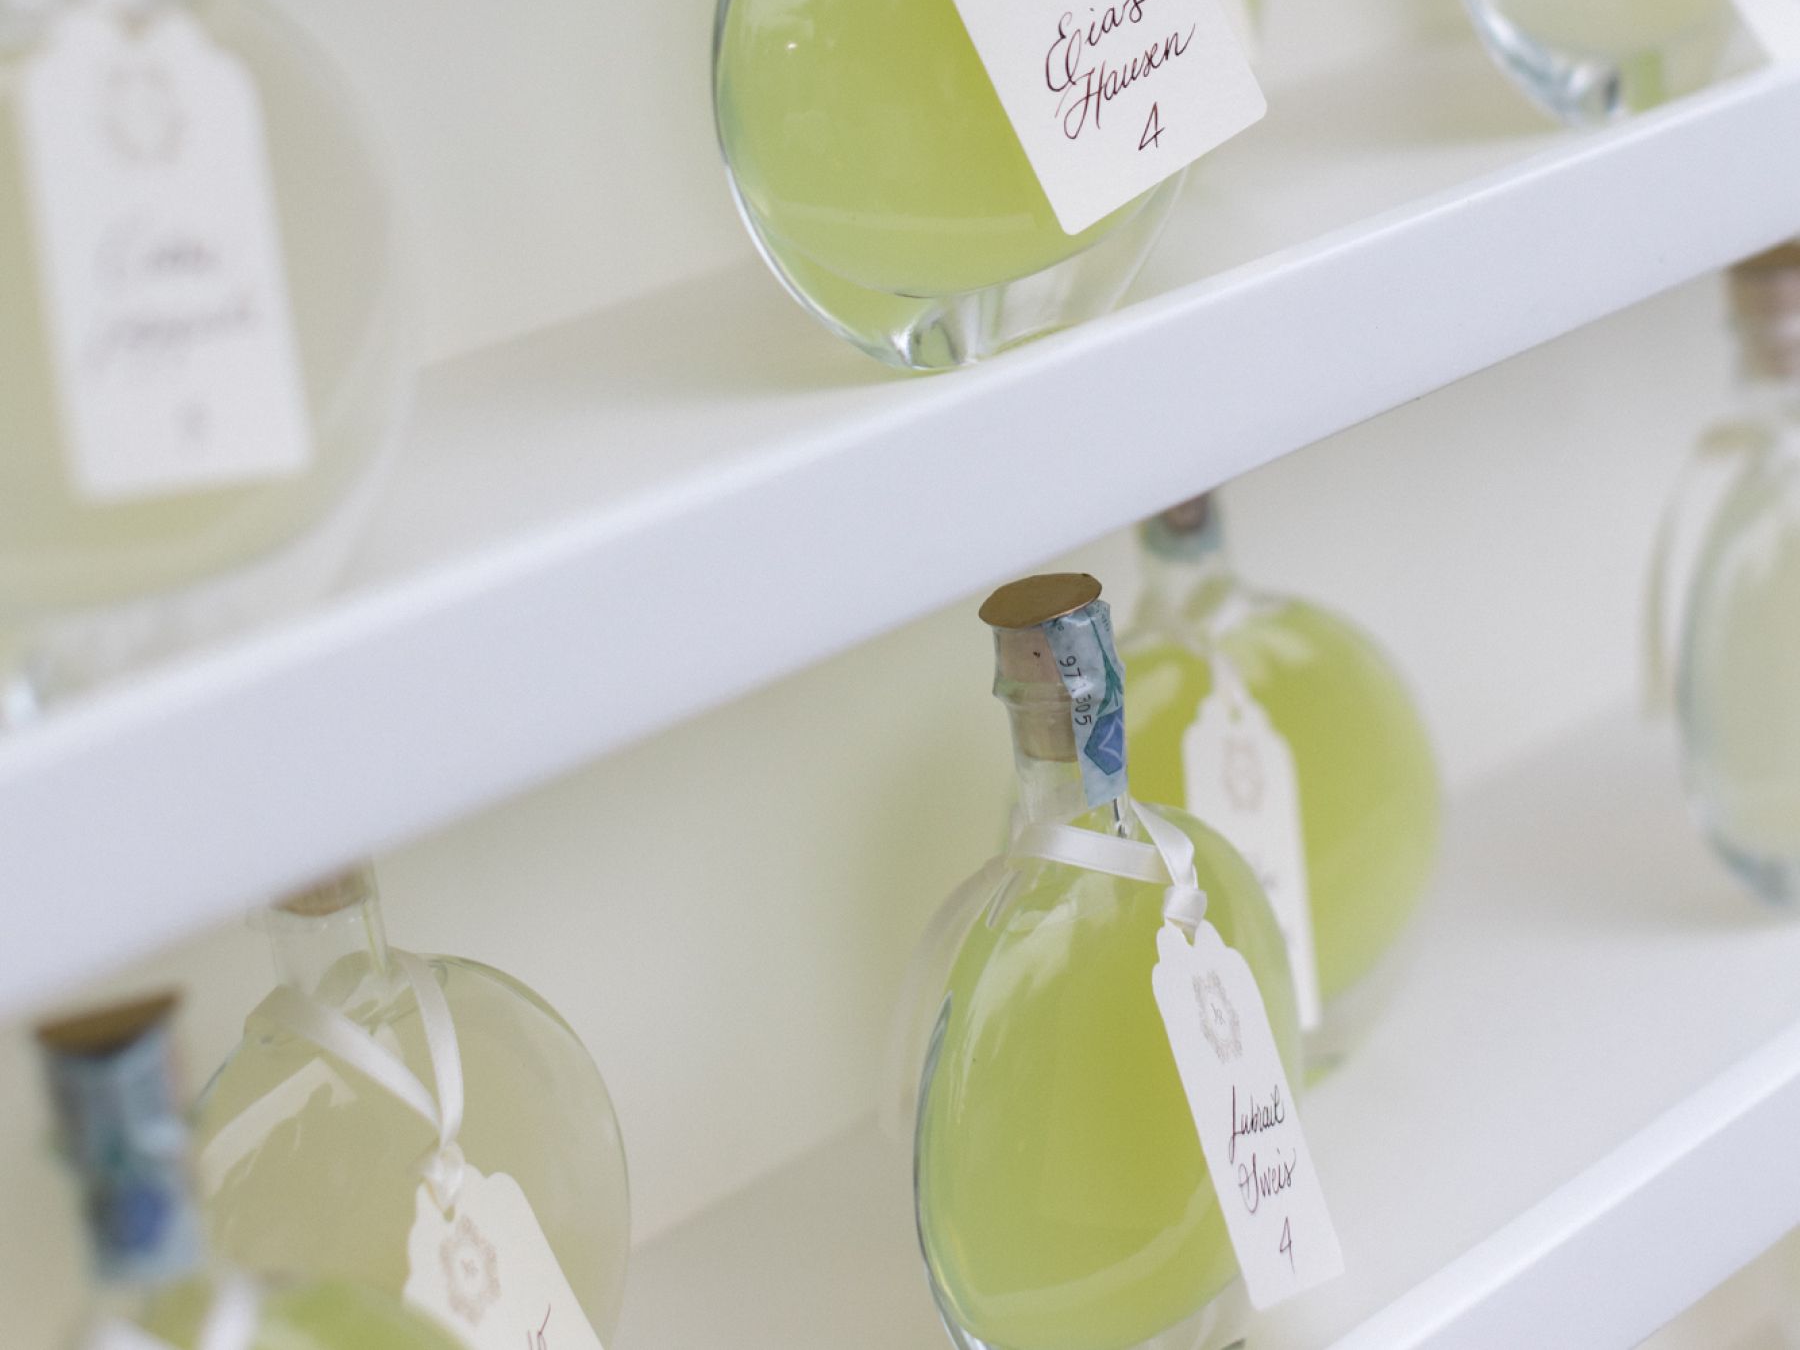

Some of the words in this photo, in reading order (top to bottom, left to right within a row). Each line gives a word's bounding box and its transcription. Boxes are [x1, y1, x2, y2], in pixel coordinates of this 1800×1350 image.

[1055, 22, 1196, 140] Hausen
[1138, 101, 1166, 151] 4
[1279, 1216, 1296, 1275] 4
